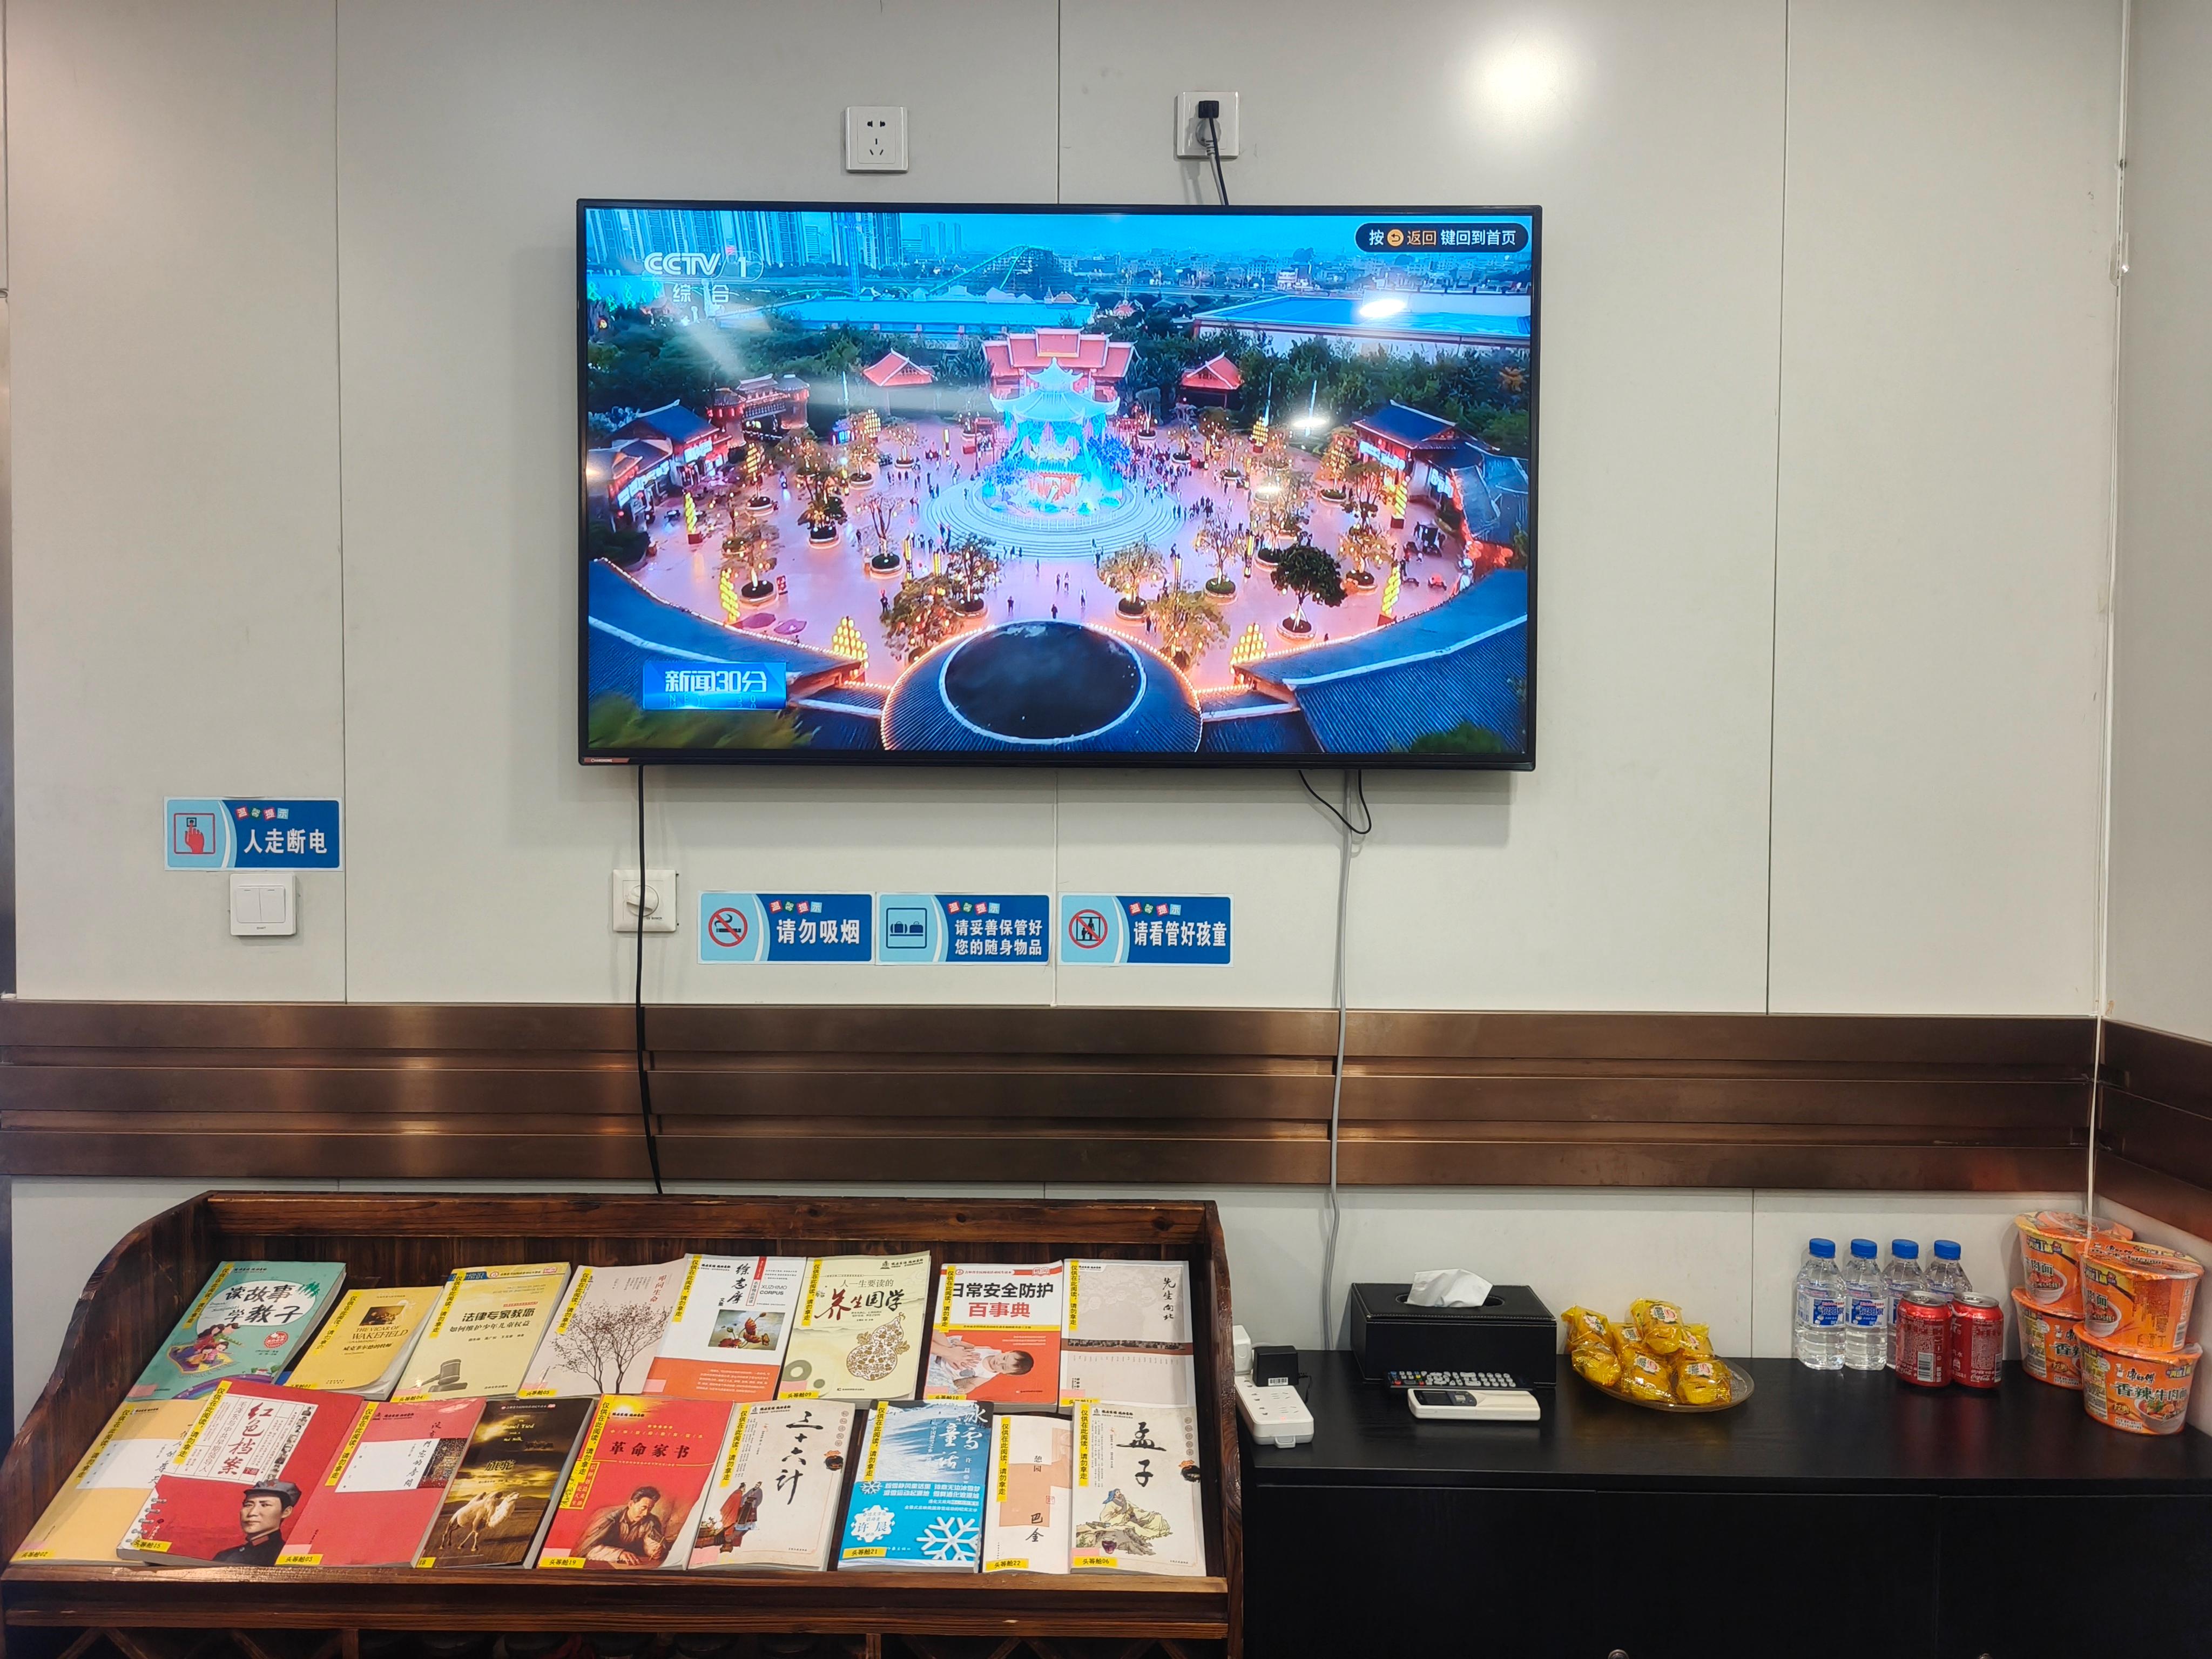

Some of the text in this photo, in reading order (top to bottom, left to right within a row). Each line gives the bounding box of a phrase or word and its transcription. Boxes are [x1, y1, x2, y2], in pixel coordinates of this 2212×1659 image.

[1369, 230, 1516, 246] 按 返回 键回到首页
[644, 252, 722, 276] CCTV
[672, 284, 731, 304] 综合
[665, 671, 767, 692] 新闻30分
[244, 828, 327, 854] 人走断电
[776, 919, 860, 944] 请勿吸烟
[955, 919, 1042, 936] 请妥善保管好
[1134, 920, 1226, 947] 请看管好孩童
[955, 939, 1042, 955] 您的随身物品
[226, 1284, 296, 1303] 读故事
[727, 1263, 751, 1304] 徐志摩
[840, 1279, 894, 1288] 人一生要读的
[953, 1283, 1054, 1298] 日常安全防护
[814, 1288, 905, 1320] 养生国学
[1163, 1277, 1176, 1320] 先生向北
[225, 1305, 303, 1323] 学教子
[462, 1308, 535, 1323] 法律专家教您
[968, 1302, 1031, 1318] 百事典
[353, 1330, 408, 1339] WAKEFIELD
[449, 1320, 531, 1332] 如何维护少年儿童权益
[2114, 1382, 2188, 1402] 香辣牛肉面
[218, 1402, 274, 1475] 红色档案
[610, 1441, 690, 1459] 革命家书
[776, 1411, 824, 1505] 三十六计
[1116, 1421, 1167, 1487] 孟子
[1026, 1513, 1044, 1542] 巴金
[994, 1560, 1021, 1568] 头等舱22
